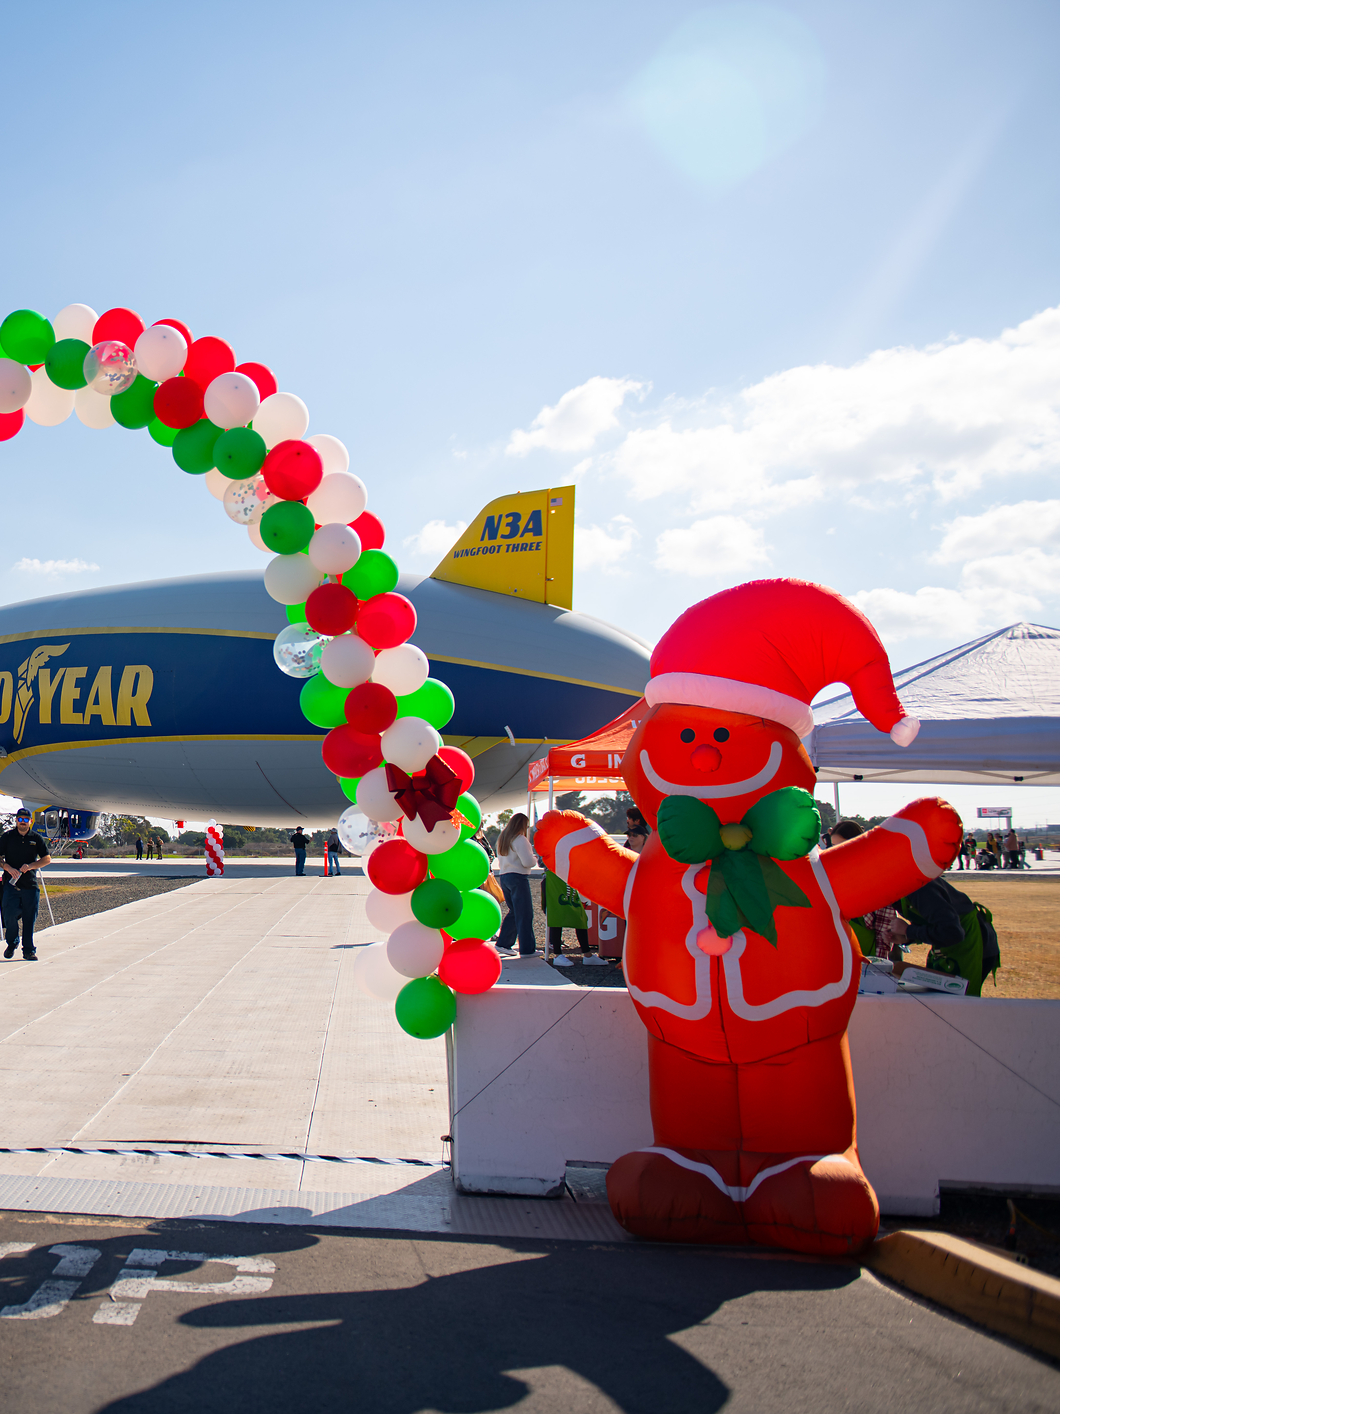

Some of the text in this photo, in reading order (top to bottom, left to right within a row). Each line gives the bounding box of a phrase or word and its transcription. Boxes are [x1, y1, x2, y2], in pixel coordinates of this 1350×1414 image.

[479, 509, 543, 541] N3A
[453, 541, 543, 559] WINGFOOT THREE
[570, 753, 586, 769] G
